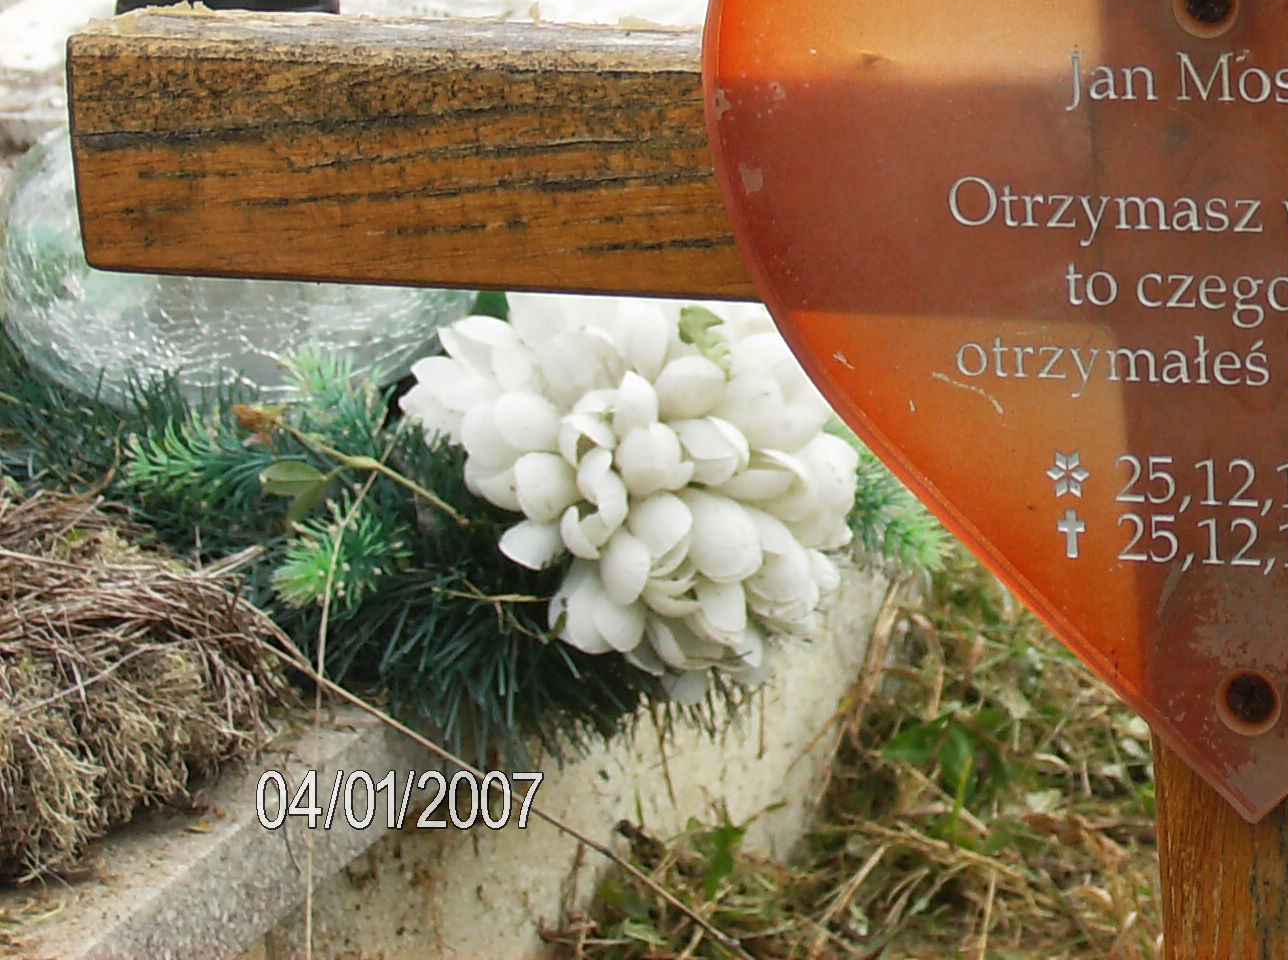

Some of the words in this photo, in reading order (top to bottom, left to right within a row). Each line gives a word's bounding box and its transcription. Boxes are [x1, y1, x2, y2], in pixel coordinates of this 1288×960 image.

[1066, 49, 1158, 111] Jan
[948, 176, 1263, 246] Otrzymasz
[1066, 262, 1118, 307] to
[956, 336, 1269, 398] otrzymałeś
